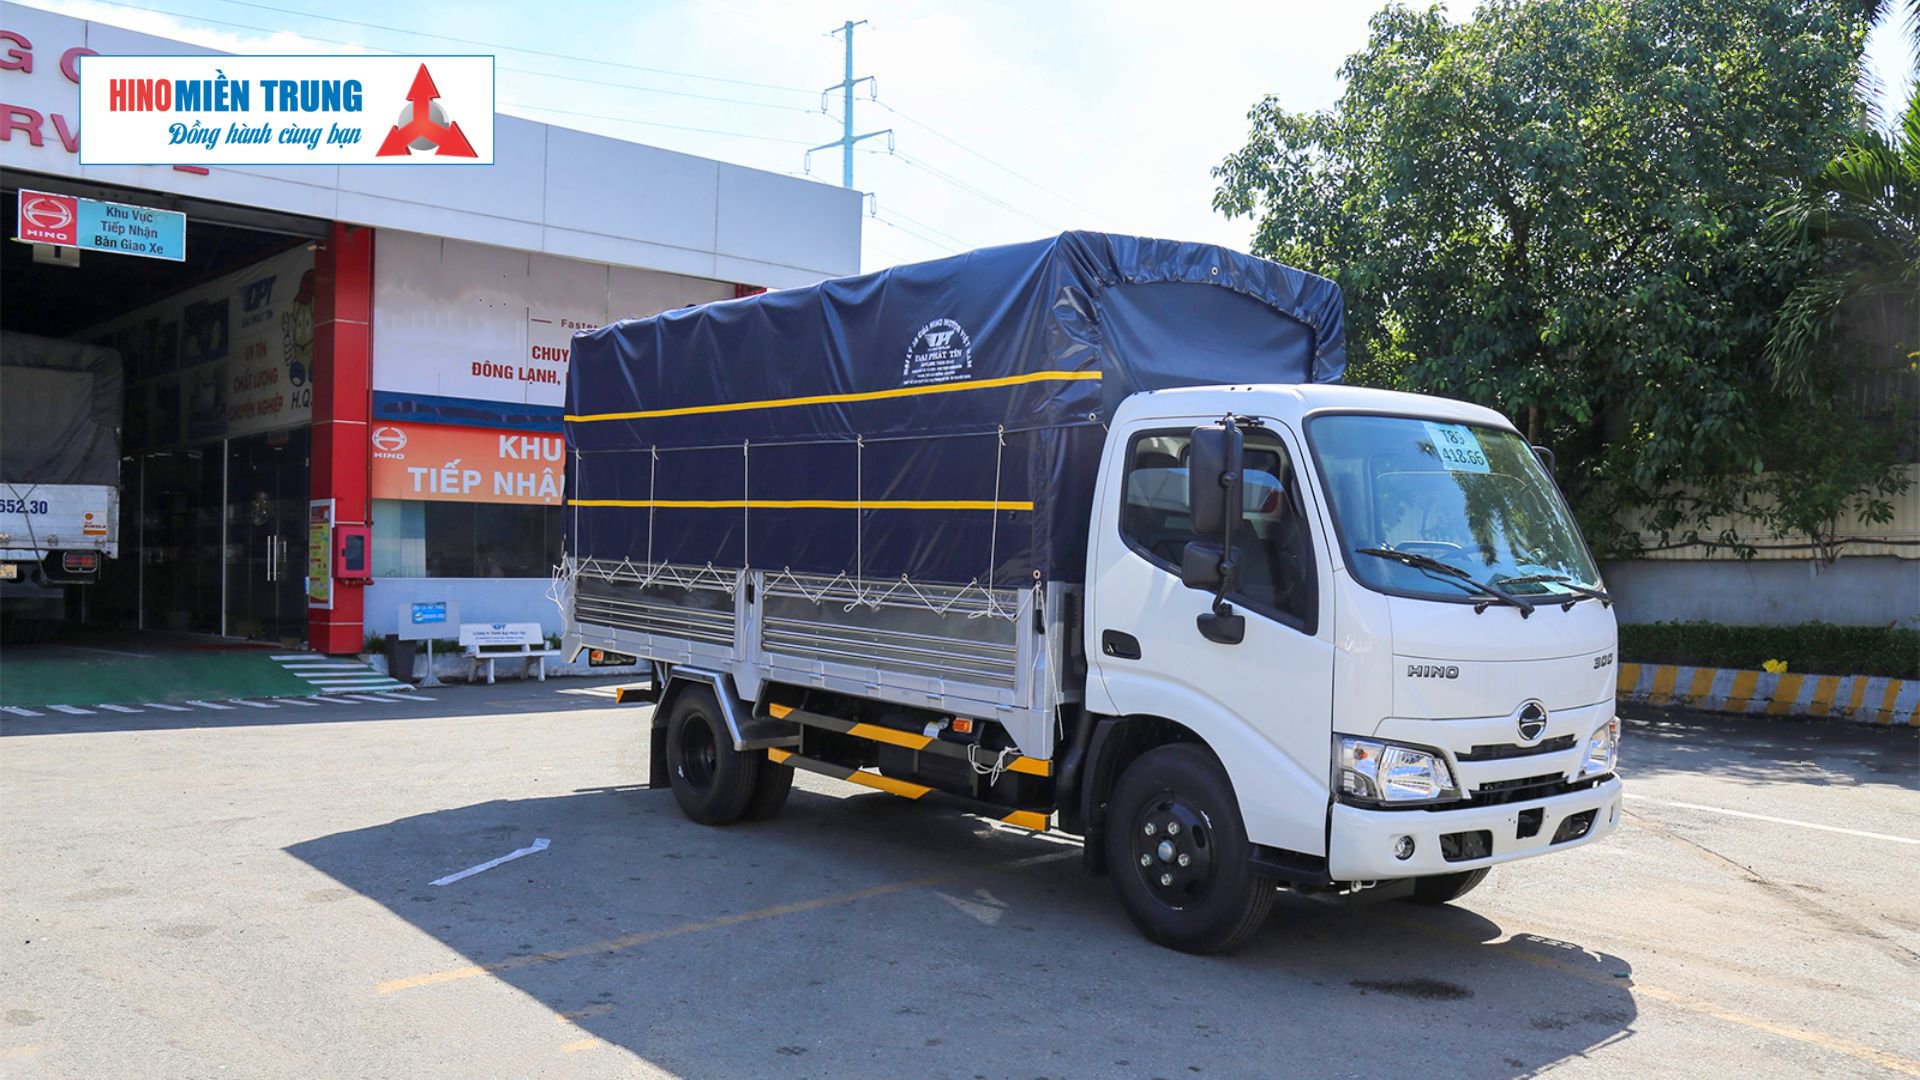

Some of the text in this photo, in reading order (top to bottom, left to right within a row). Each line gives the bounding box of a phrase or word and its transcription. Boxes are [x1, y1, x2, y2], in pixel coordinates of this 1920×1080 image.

[106, 206, 153, 223] Khu Vực
[26, 229, 68, 241] HINO
[100, 220, 158, 239] Tiếp Nhận
[120, 238, 146, 252] Giao
[149, 242, 164, 256] Xe
[373, 435, 562, 461] HINO KHU
[1442, 447, 1485, 466] 418.66
[407, 458, 565, 503] TIẾP NHẬ
[1593, 653, 1614, 670] 300
[1407, 665, 1460, 680] HINO
